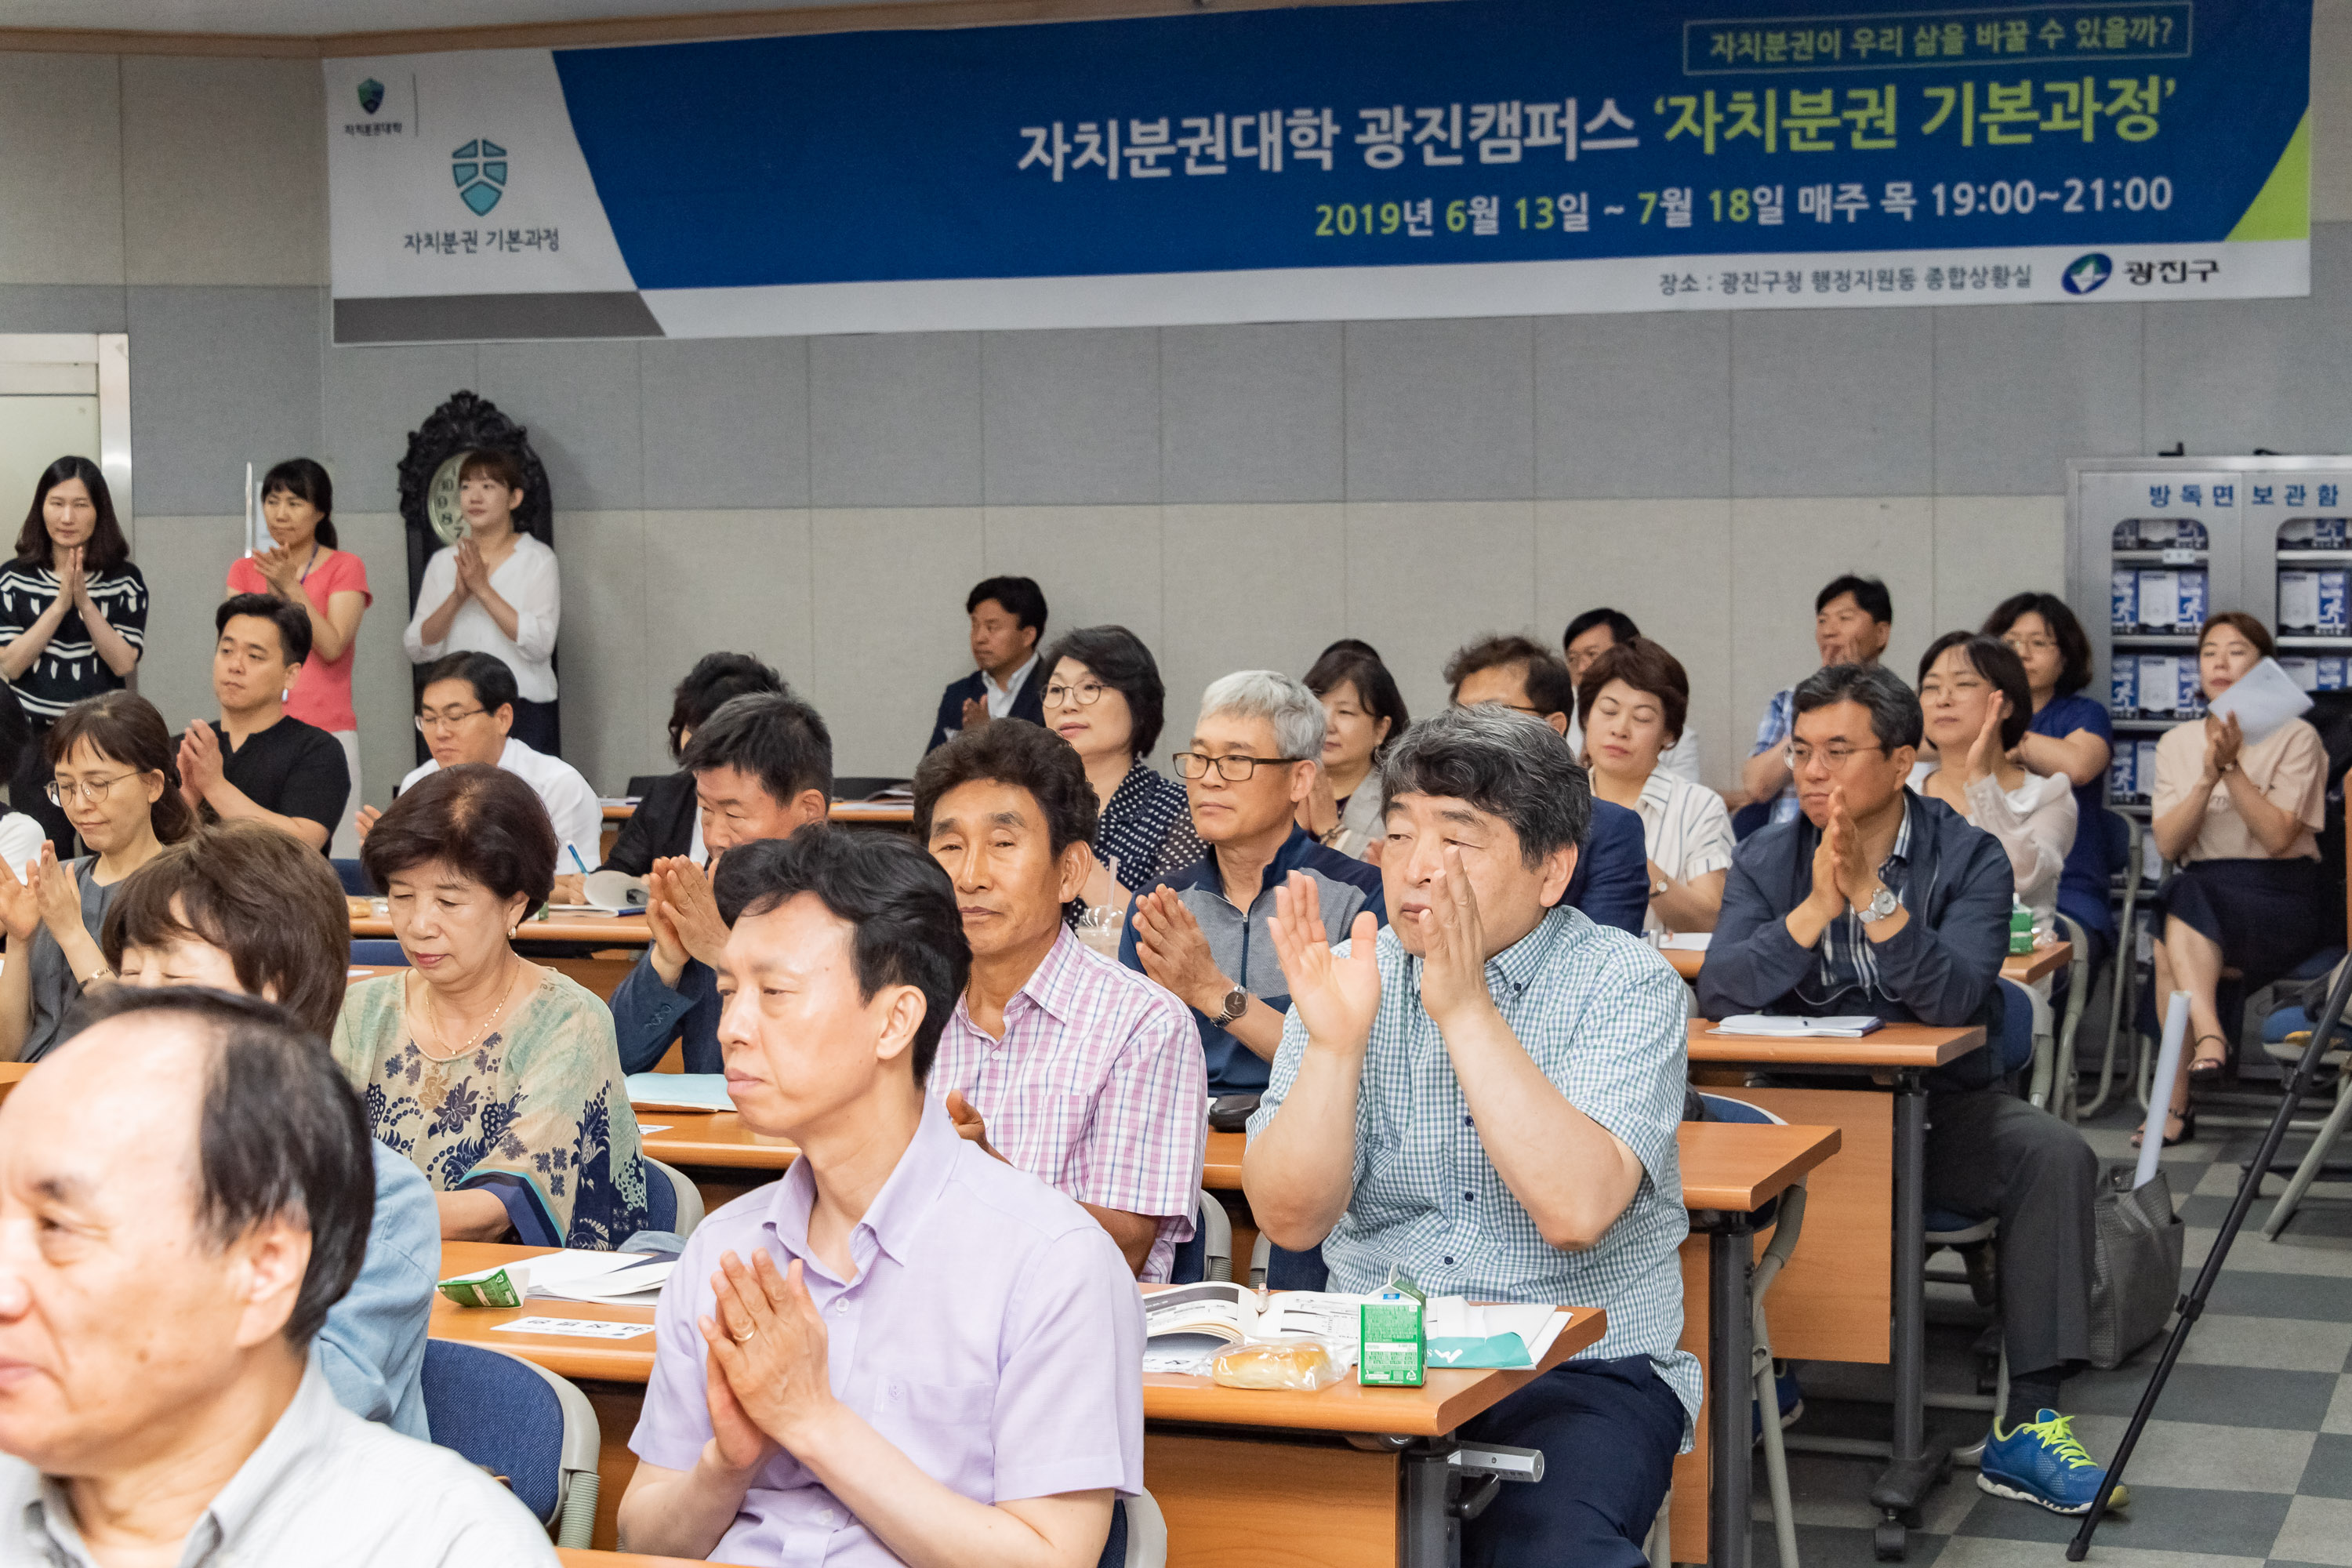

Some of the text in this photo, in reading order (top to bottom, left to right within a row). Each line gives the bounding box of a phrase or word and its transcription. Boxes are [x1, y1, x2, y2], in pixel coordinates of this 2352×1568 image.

[1709, 16, 2173, 64] 자치분권이 우리 삶을 바꿀 수 있을까?
[1018, 108, 1341, 182] 자치분권대학
[1356, 98, 1639, 169] 광진캠퍼스
[1316, 198, 1433, 236] 2019년
[1446, 196, 1498, 235] 6월
[1516, 192, 1588, 232] 13일
[1639, 188, 1691, 227] 7월
[1710, 185, 1783, 225] 18일
[1798, 184, 1869, 223] 매주
[1881, 182, 1917, 220] 목
[1933, 176, 2172, 216] 19:00~21:00
[405, 228, 558, 254] 자치분권 기본과정
[1661, 274, 1699, 296] 장소
[1721, 270, 1802, 294] 광진구청
[1813, 268, 1915, 292] 행정지원동
[1926, 266, 2031, 290] 종합상황실
[2127, 260, 2219, 285] 광진구
